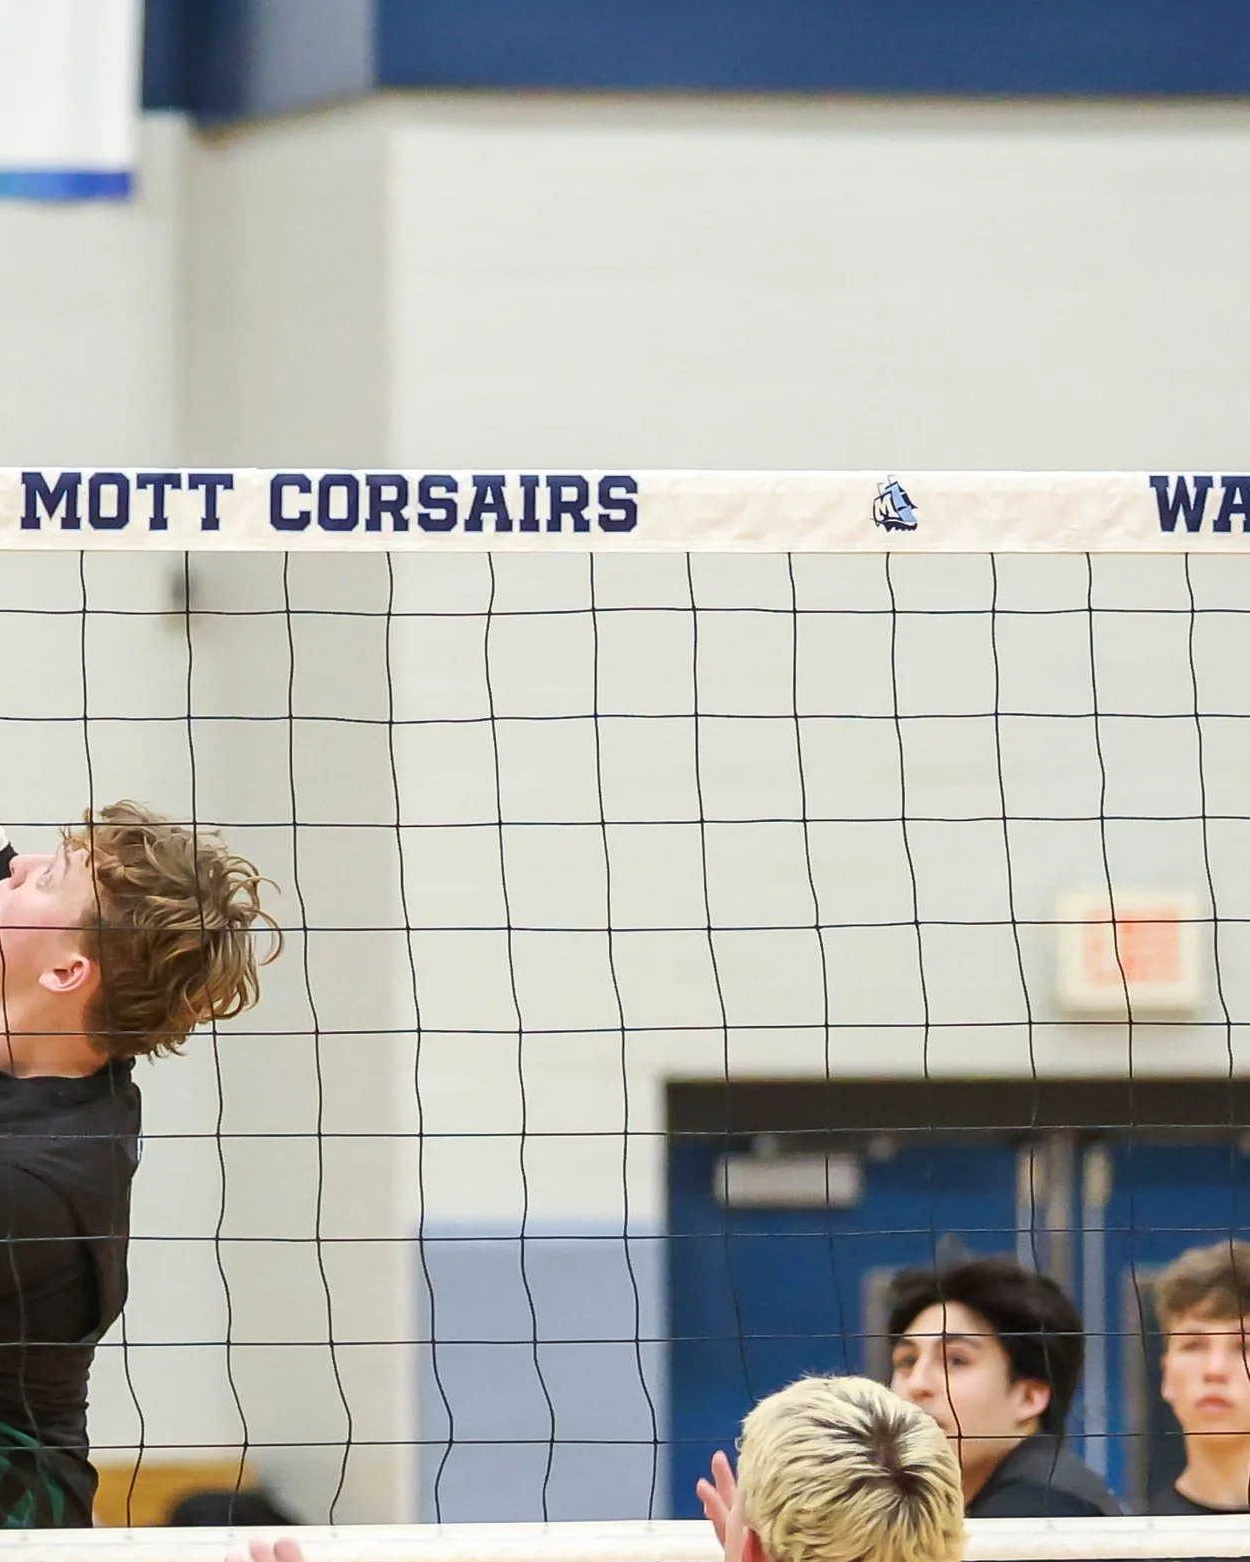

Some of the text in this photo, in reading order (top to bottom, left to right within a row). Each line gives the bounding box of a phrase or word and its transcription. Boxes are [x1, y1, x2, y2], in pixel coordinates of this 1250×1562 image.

[20, 471, 234, 531] MOTT
[269, 473, 638, 533] CORSAIRS
[1149, 475, 1250, 533] WA
